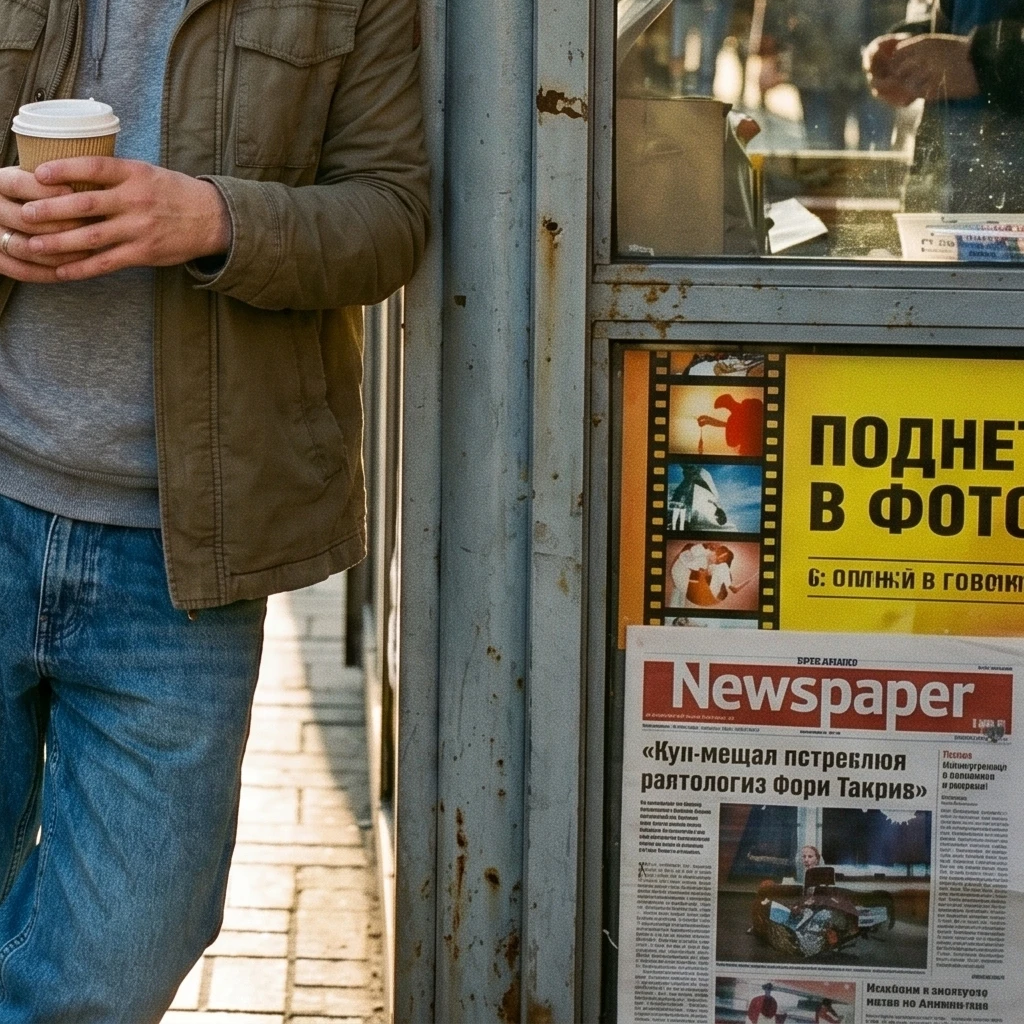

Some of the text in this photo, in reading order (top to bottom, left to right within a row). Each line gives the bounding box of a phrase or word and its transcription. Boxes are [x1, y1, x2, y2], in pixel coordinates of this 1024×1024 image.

[810, 415, 1024, 479] ПОДНЕ
[809, 482, 846, 532] В
[922, 572, 935, 590] В
[672, 660, 975, 731] Newspaper
